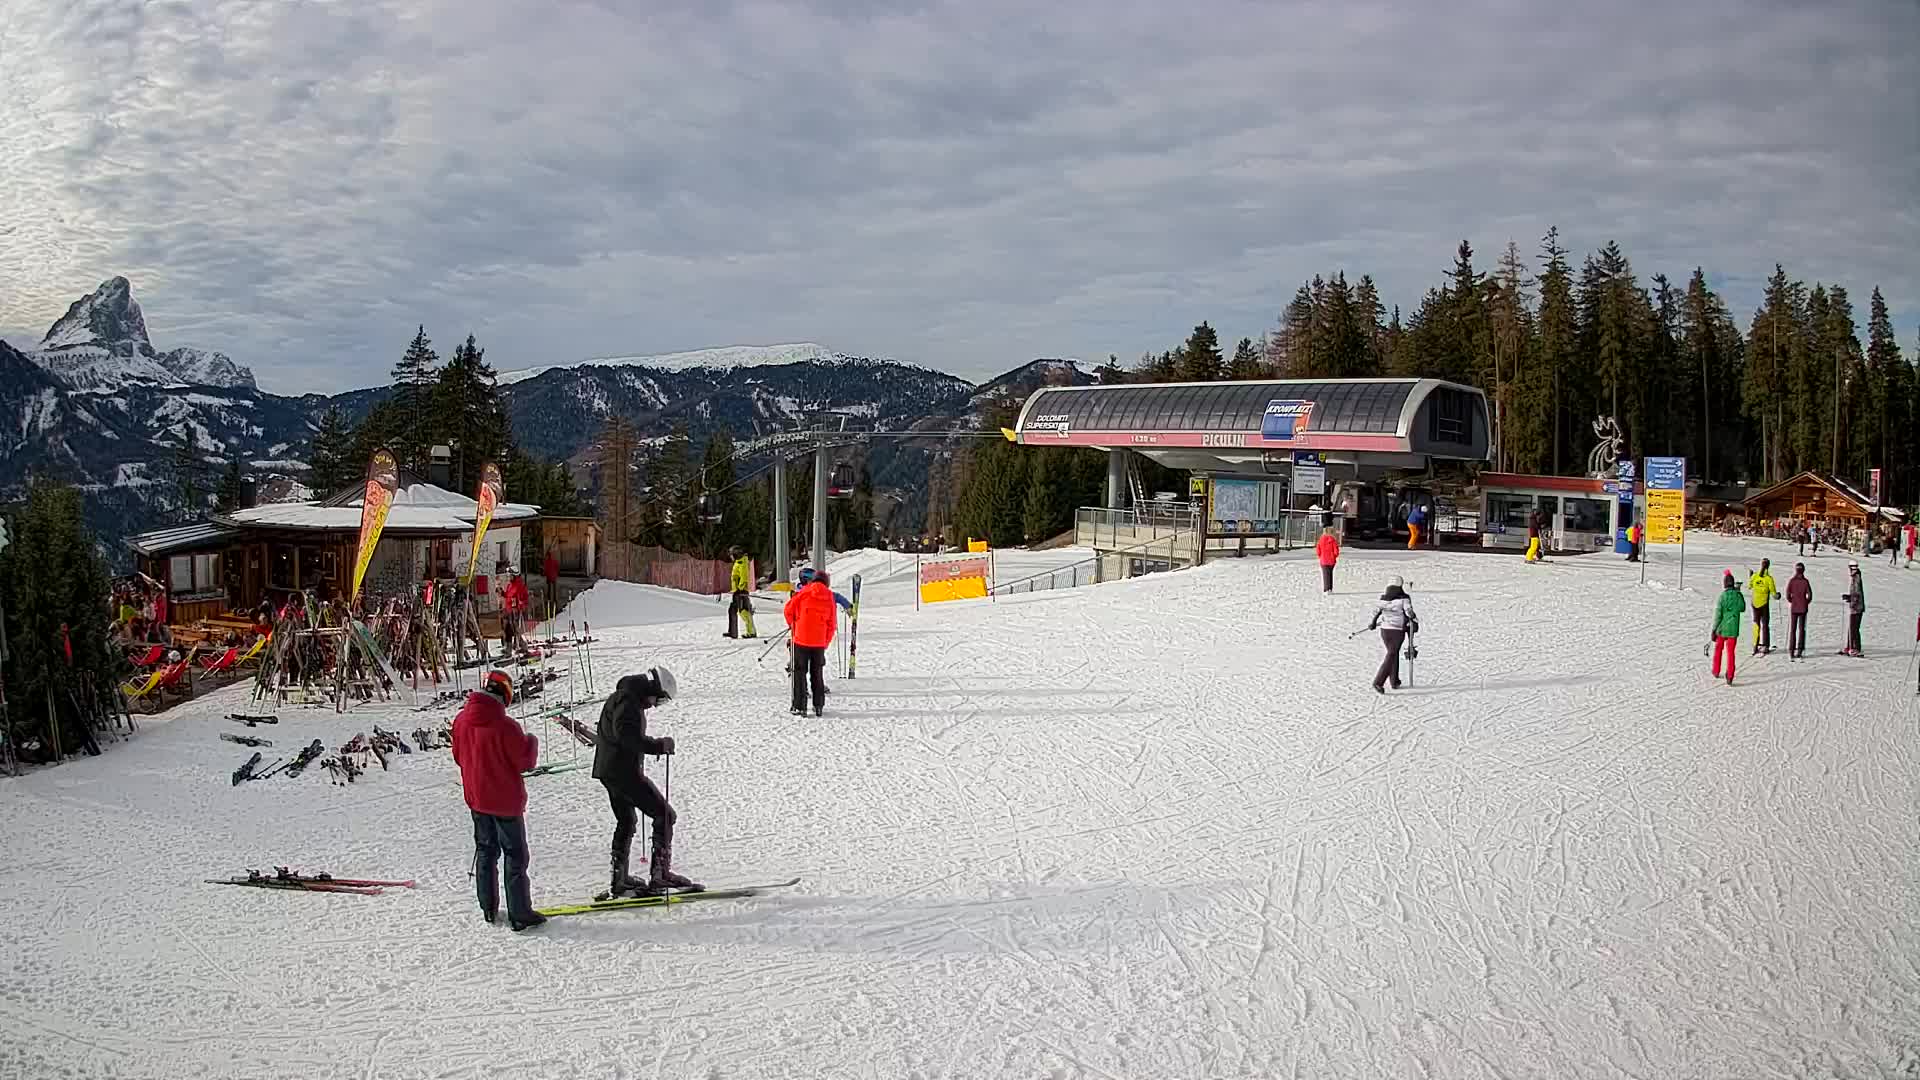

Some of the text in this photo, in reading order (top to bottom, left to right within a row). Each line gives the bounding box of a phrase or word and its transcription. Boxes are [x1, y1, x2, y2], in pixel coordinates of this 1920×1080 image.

[1266, 405, 1310, 413] KRONPLATZ
[1036, 414, 1069, 422] DOLOMITI
[1202, 434, 1245, 447] PICULIN
